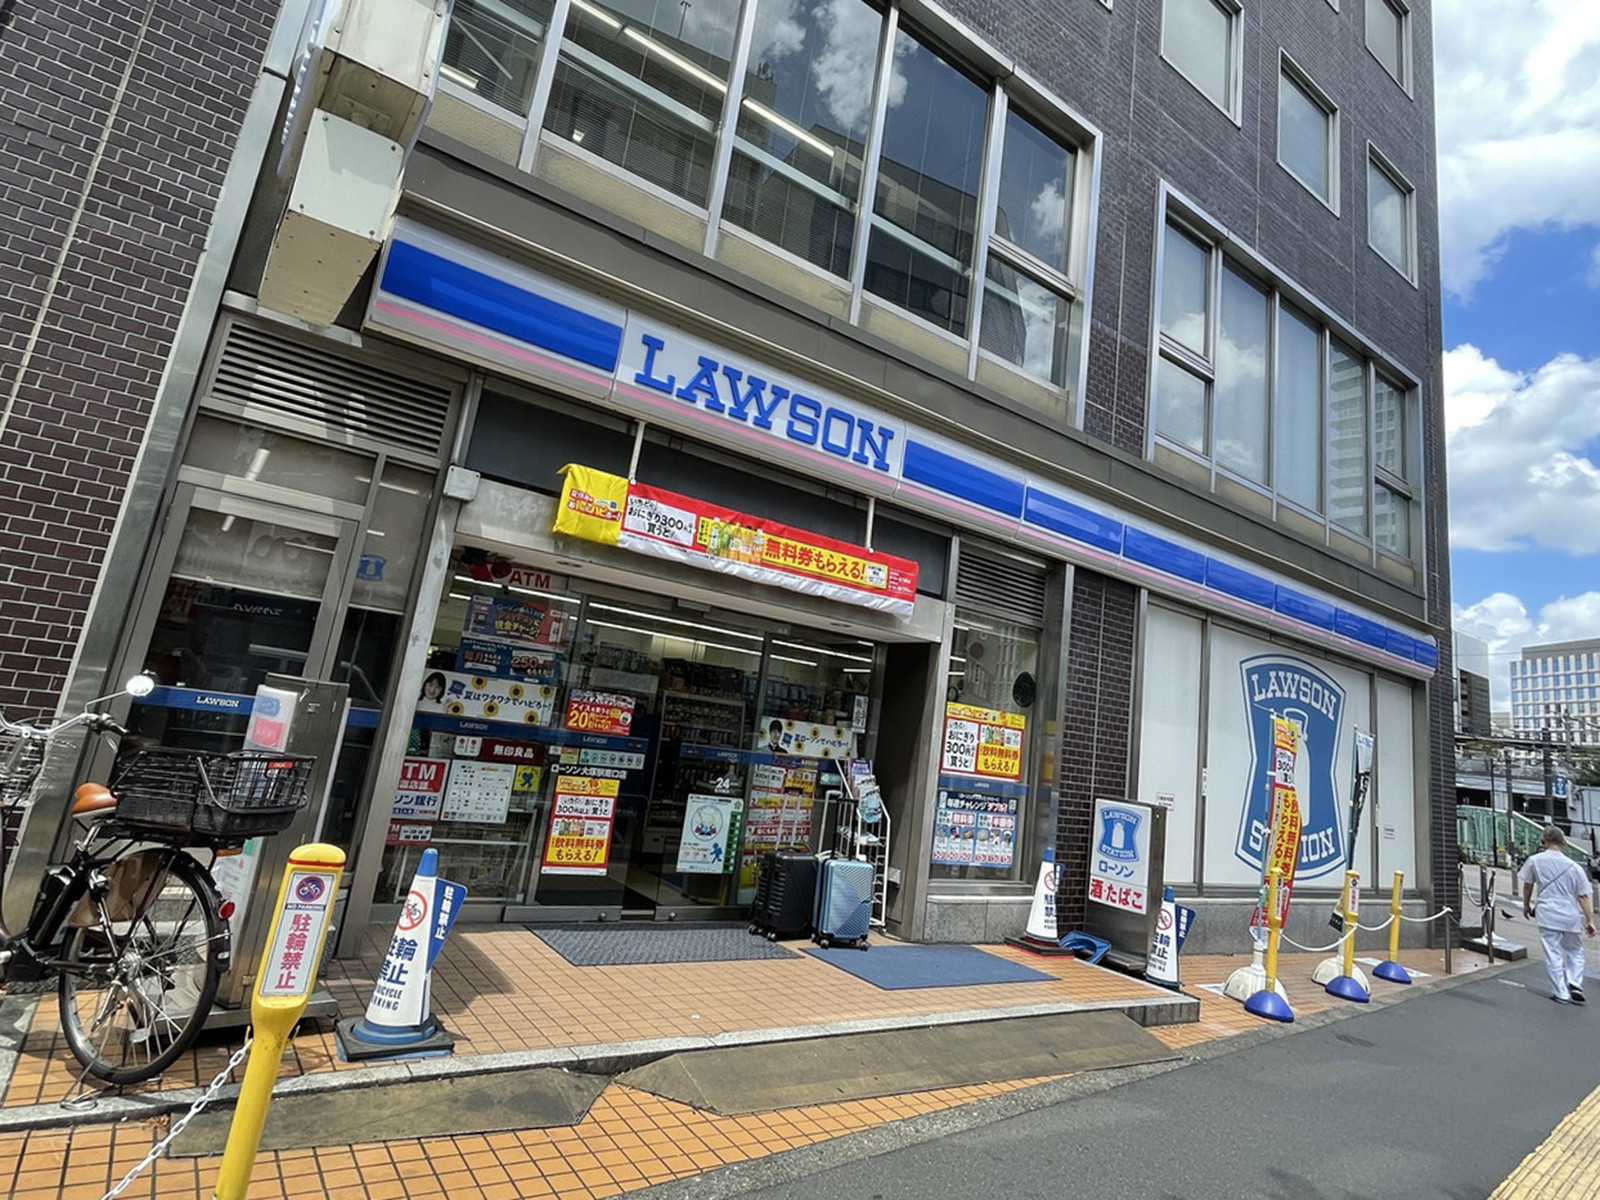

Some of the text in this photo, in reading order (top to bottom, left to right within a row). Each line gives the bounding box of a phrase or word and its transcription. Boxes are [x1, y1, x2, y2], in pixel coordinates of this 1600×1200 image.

[634, 333, 895, 472] LAWSON
[646, 521, 673, 538] 買うと
[764, 537, 866, 581] 無料券もらえる!
[508, 570, 551, 589] ATM
[196, 695, 240, 708] LAWSON
[1251, 671, 1337, 720] LAWSON
[567, 710, 588, 728] 20
[947, 730, 975, 744] おにぎり
[492, 743, 535, 759] 無印良品
[982, 745, 1020, 761] 飲料無料券
[949, 756, 970, 769] 買うと
[983, 759, 1016, 772] もらえる!
[402, 762, 437, 780] TM
[715, 777, 730, 789] 24
[1103, 811, 1138, 825] LAWSON
[555, 837, 605, 850] 飲料無料券
[1248, 818, 1335, 863] SION
[555, 849, 600, 861] もらえる!
[1101, 843, 1135, 858] STATION
[1098, 860, 1135, 878] ローソン
[274, 913, 312, 989] 駐輪禁止
[371, 995, 400, 1011] RKING
